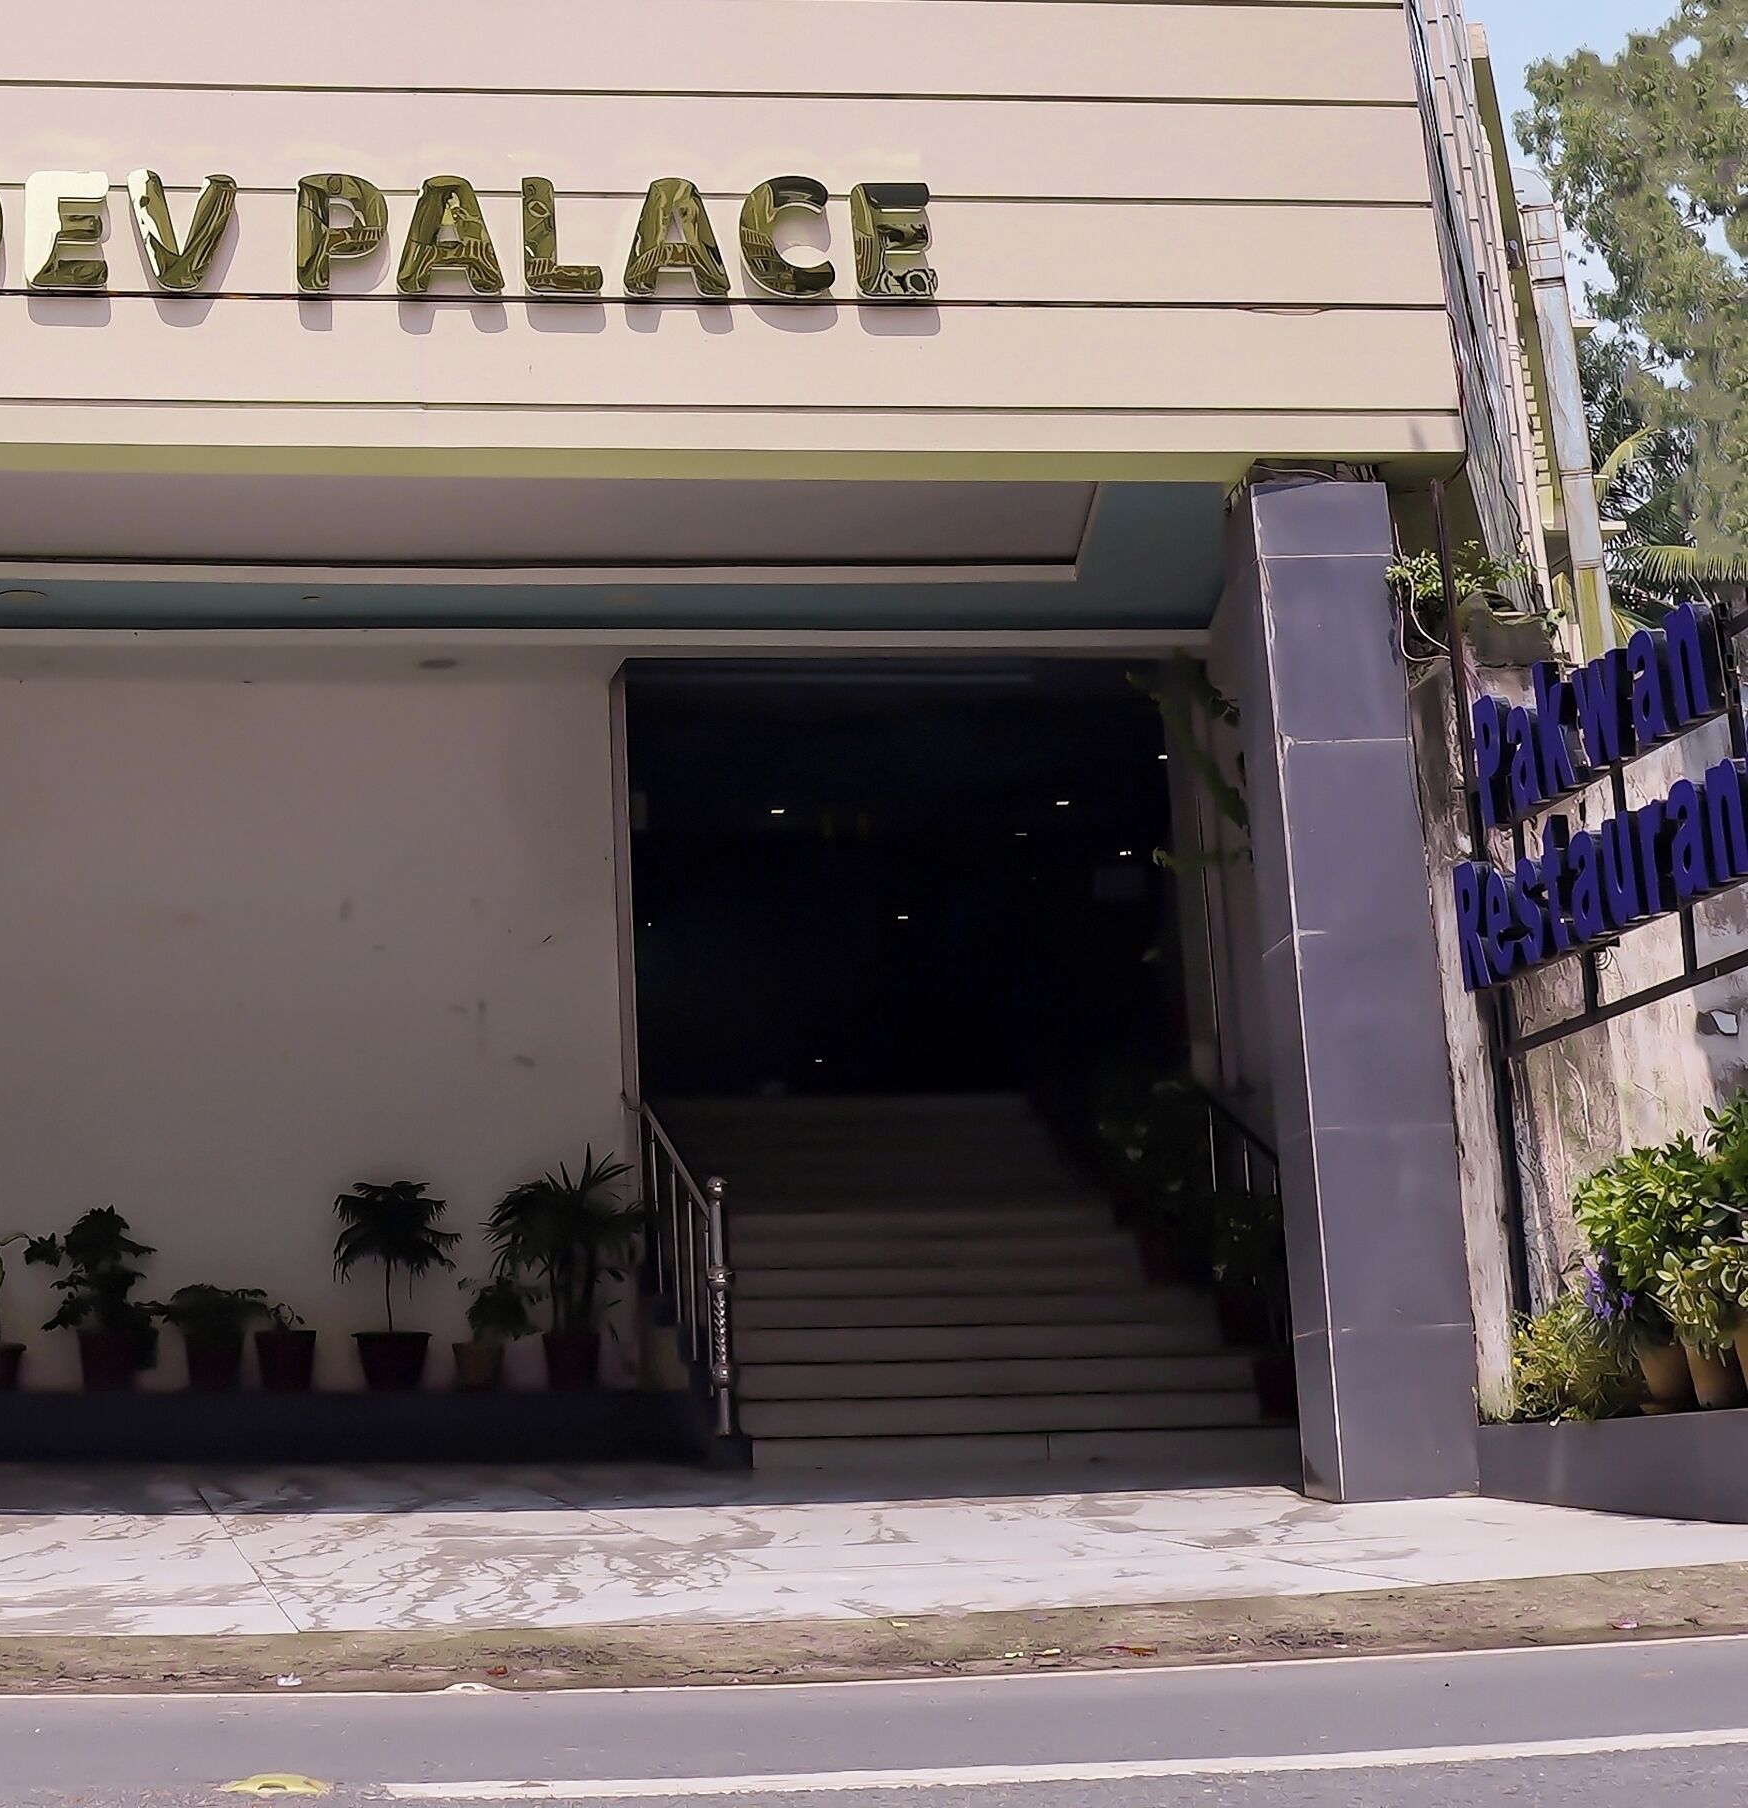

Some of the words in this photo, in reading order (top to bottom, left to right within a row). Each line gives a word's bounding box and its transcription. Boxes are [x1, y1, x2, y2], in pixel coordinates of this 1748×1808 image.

[296, 173, 938, 298] PALACE
[1473, 602, 1709, 828] Pakwan
[1453, 728, 1748, 991] Restauran
